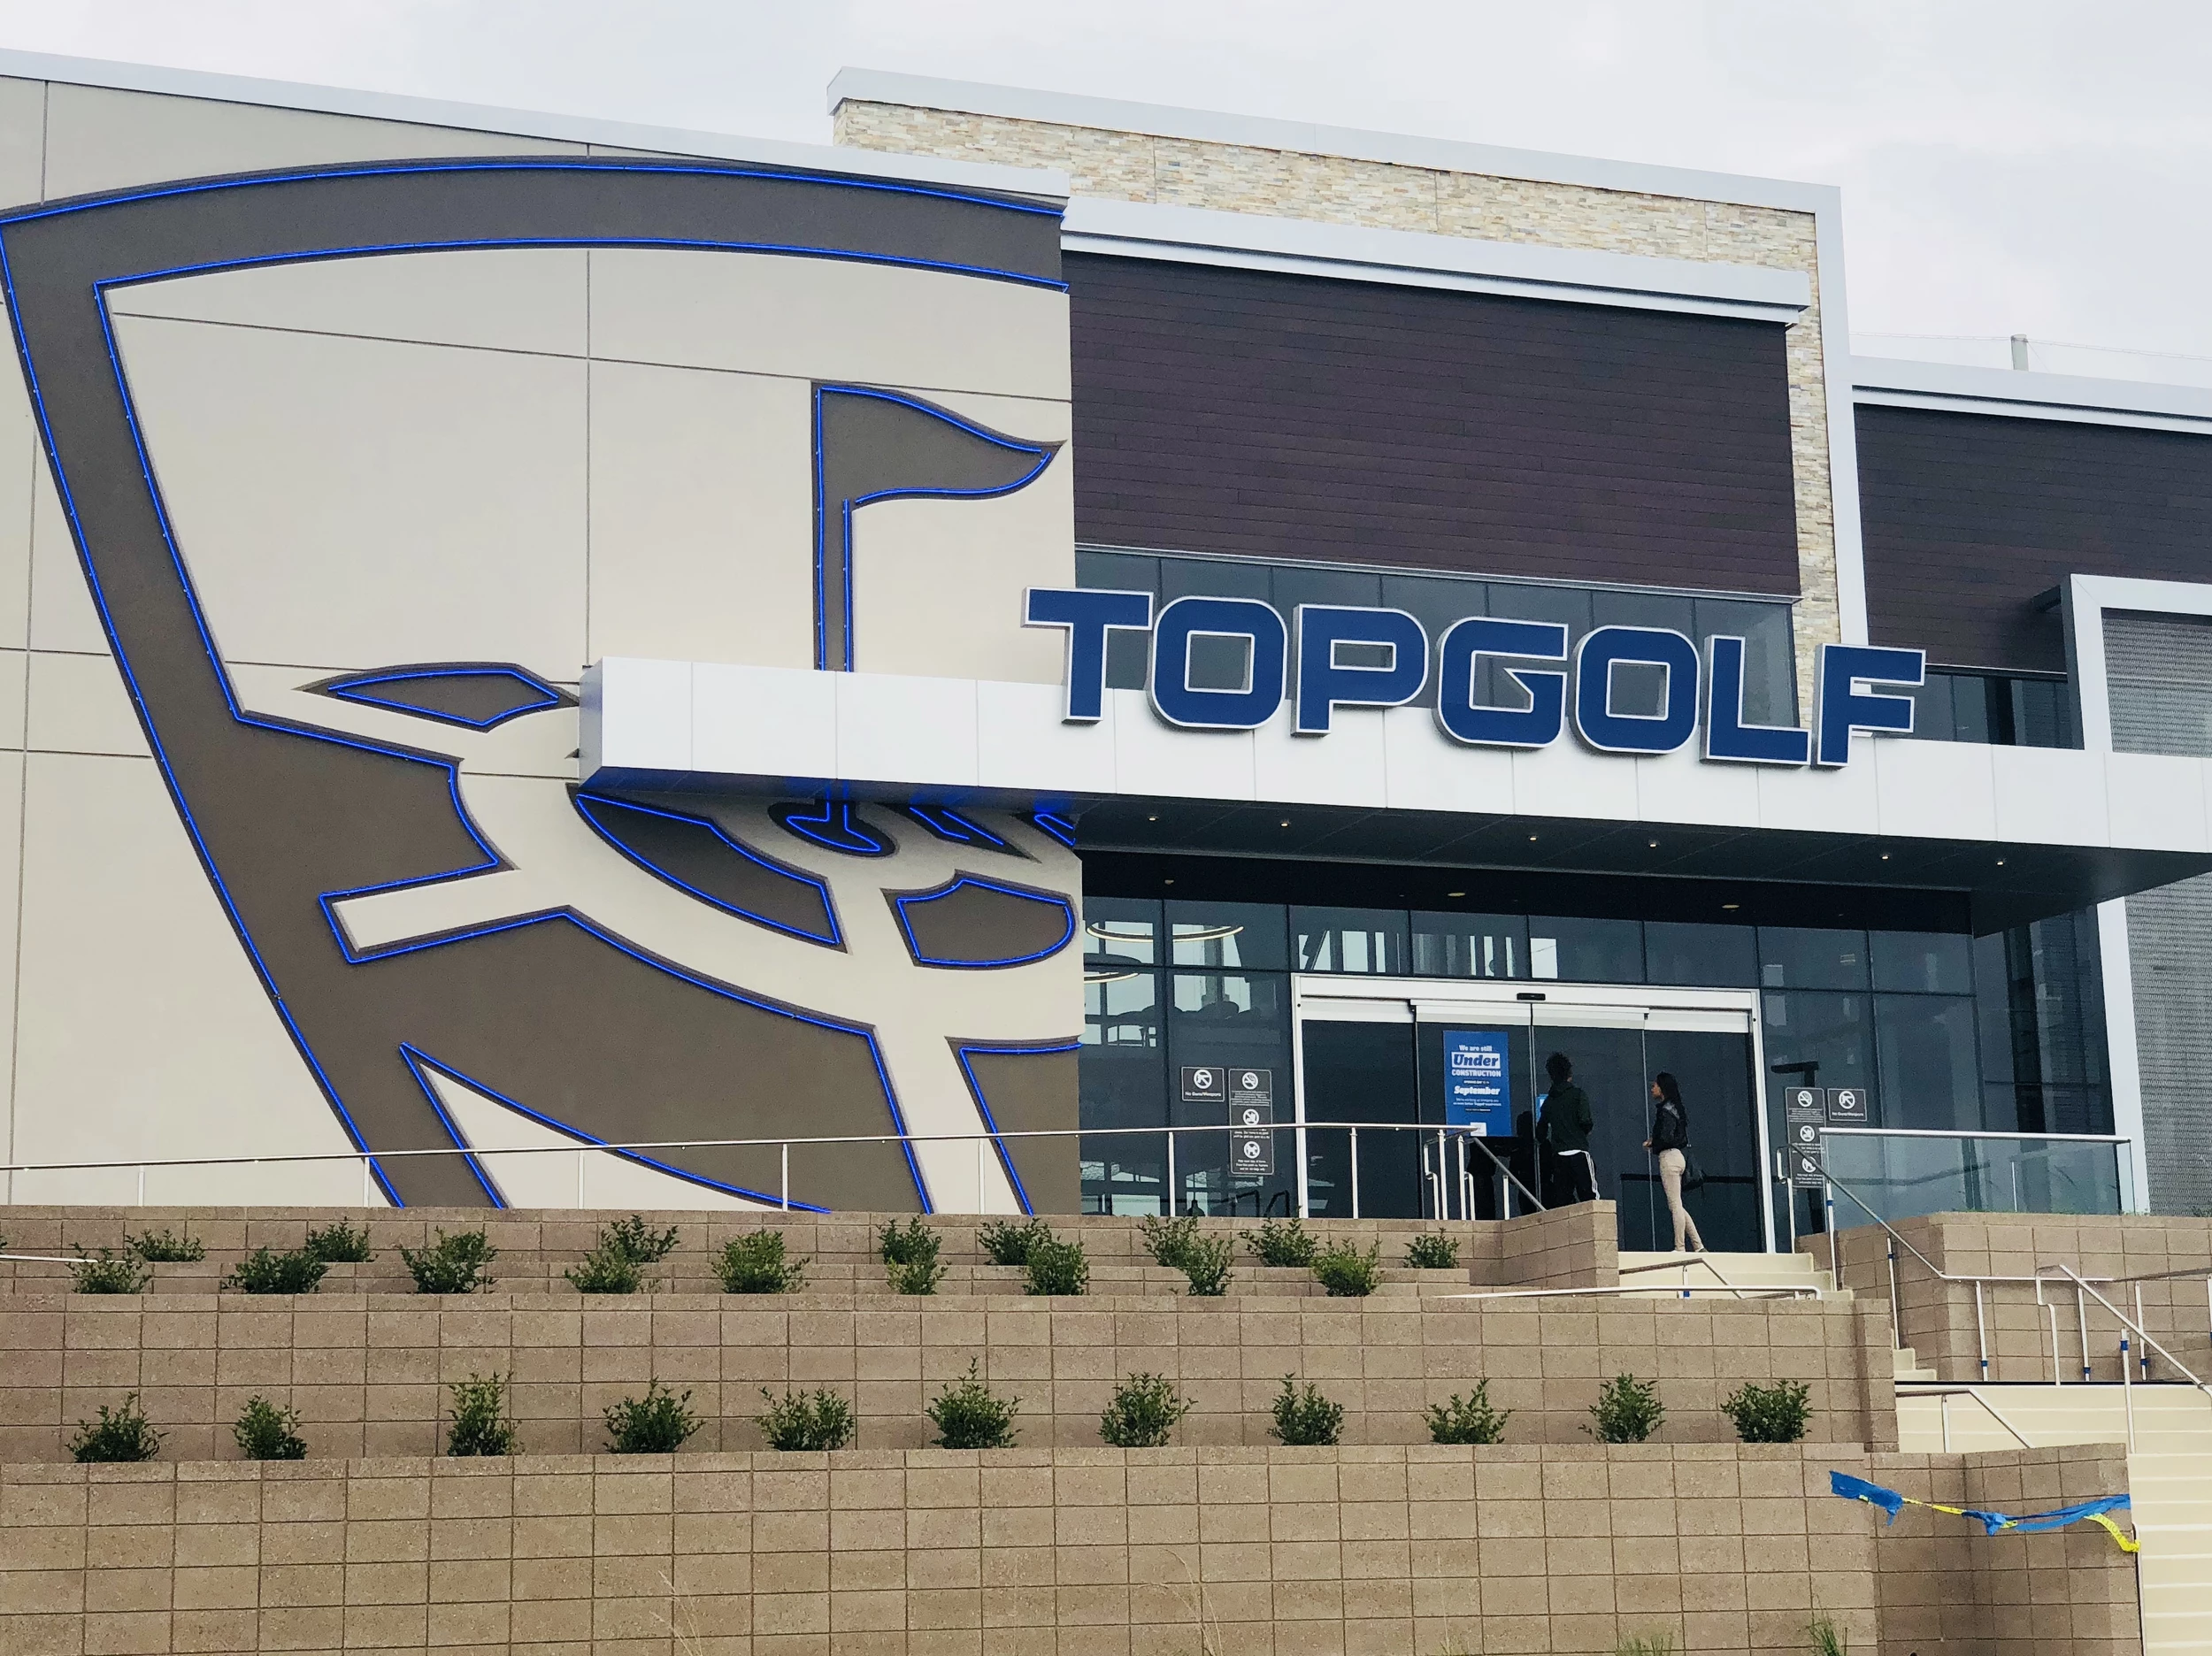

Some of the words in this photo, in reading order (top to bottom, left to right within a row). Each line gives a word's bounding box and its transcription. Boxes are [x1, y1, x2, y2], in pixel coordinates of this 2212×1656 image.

[1022, 586, 1926, 768] TOPGOLF
[1453, 1054, 1499, 1067] Under
[1451, 1069, 1502, 1077] CONSTRUCTION
[1454, 1085, 1501, 1096] September
